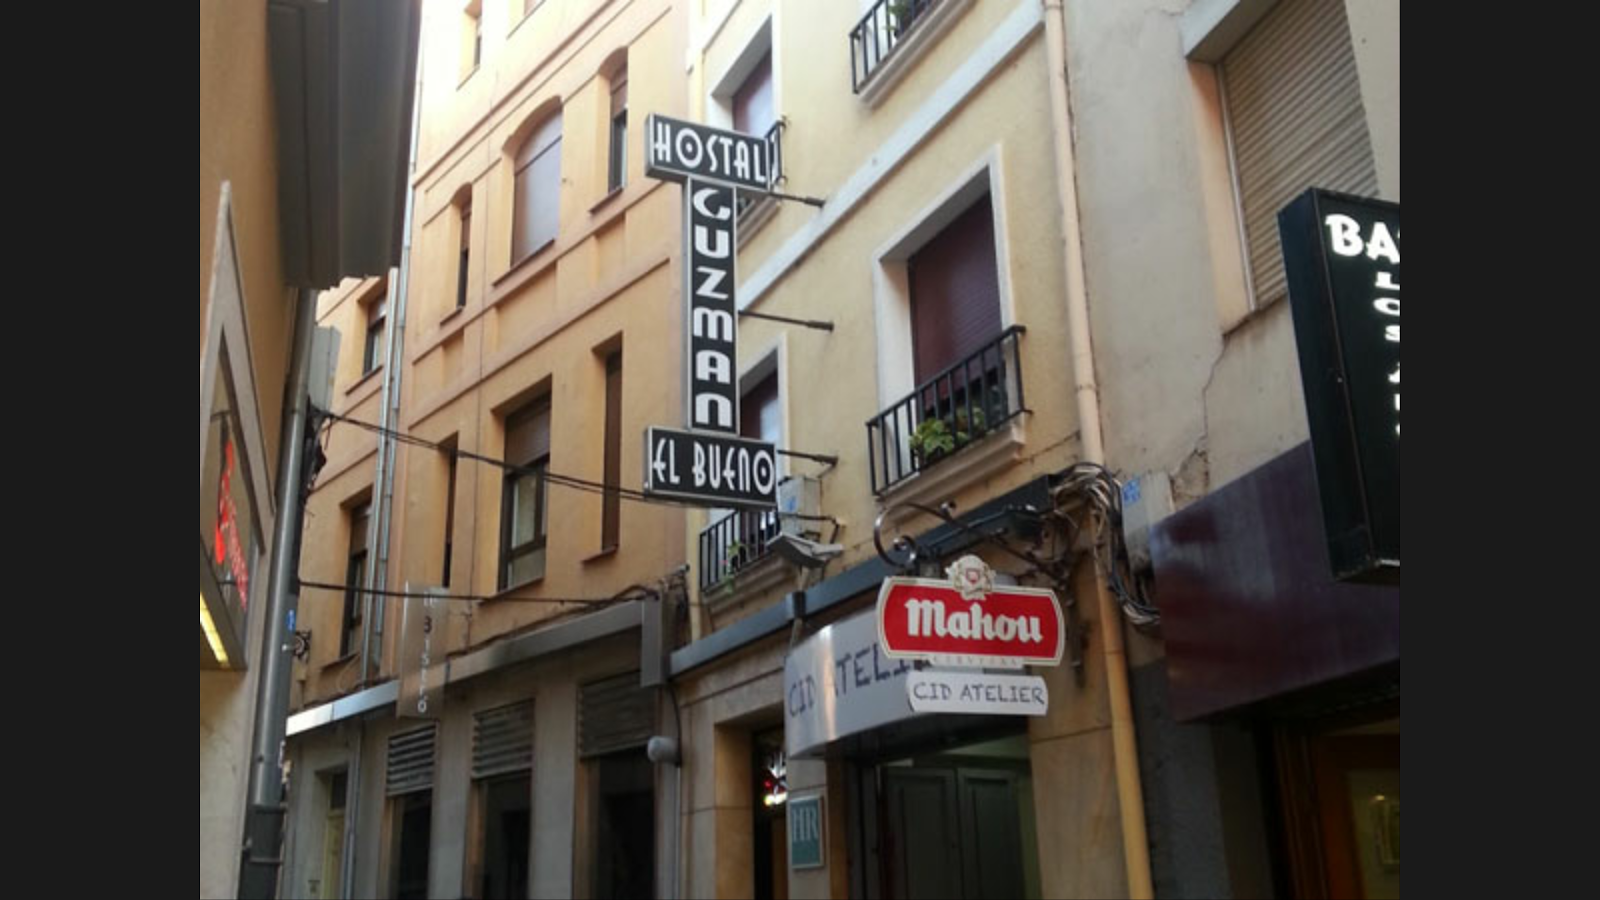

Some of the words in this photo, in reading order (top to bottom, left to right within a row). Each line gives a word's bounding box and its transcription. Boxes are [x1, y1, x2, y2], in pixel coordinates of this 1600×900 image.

[654, 121, 766, 184] HOSTAL
[1324, 214, 1400, 265] BA
[692, 187, 734, 429] GUZMAN
[653, 437, 680, 485] EL
[691, 440, 775, 495] BUENO
[904, 598, 1043, 643] Mahou
[913, 682, 952, 700] CID
[960, 685, 1045, 704] ATELIER
[792, 806, 818, 842] HR
